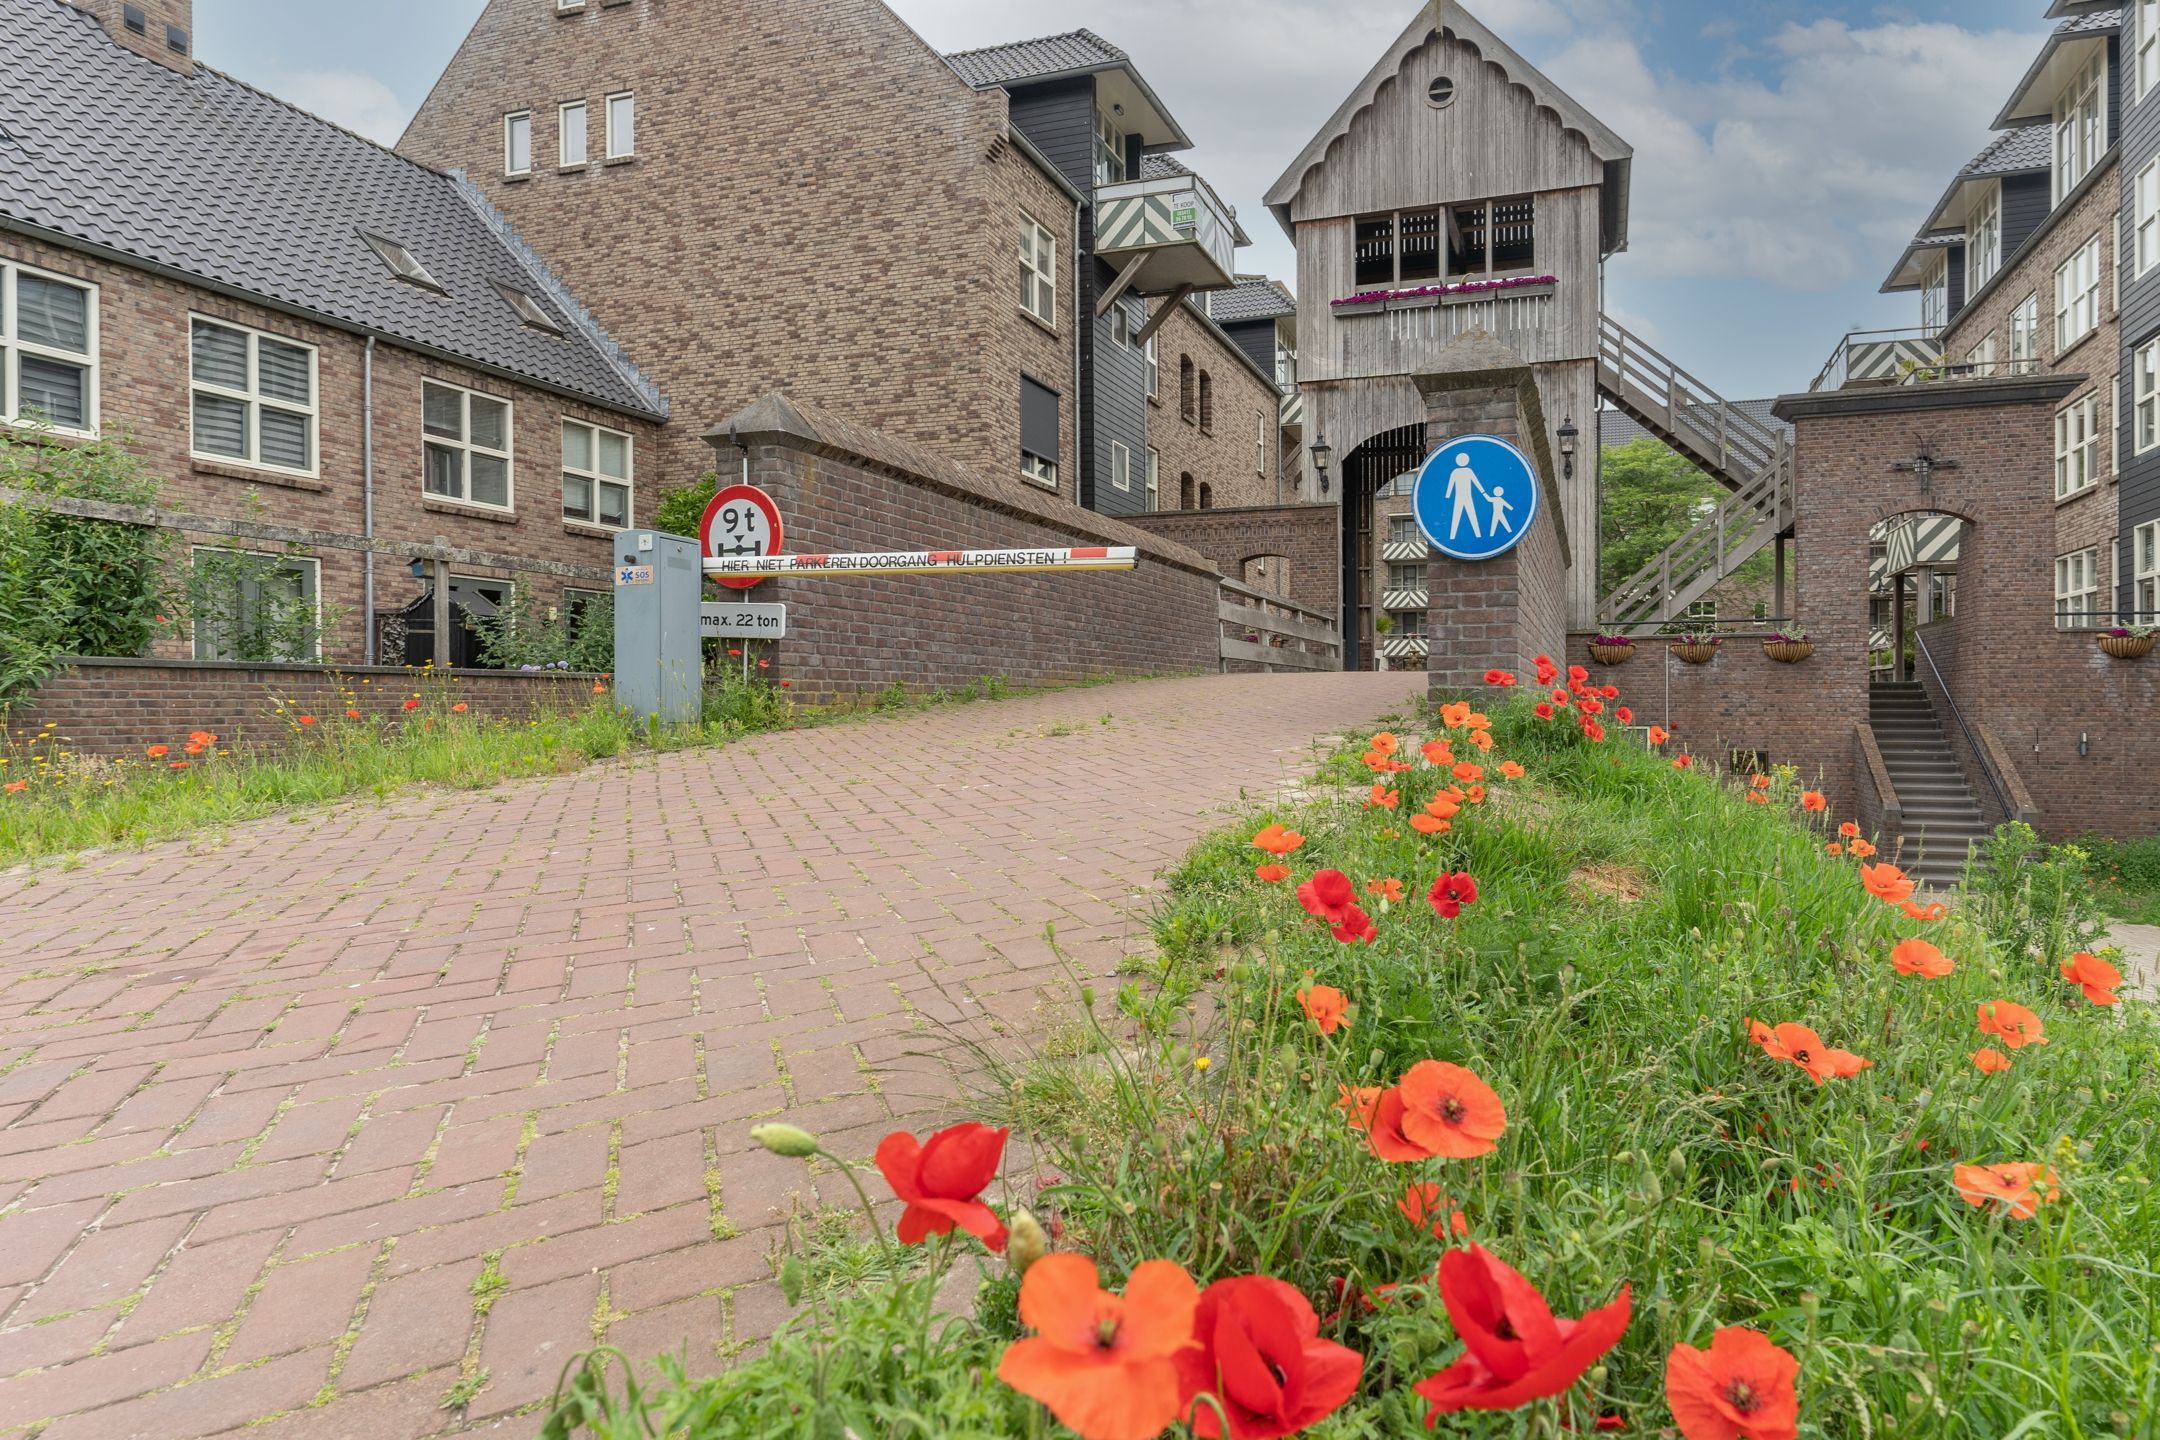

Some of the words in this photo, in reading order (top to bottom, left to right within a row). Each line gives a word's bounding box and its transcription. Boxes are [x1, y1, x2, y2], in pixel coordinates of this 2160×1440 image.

[722, 508, 739, 534] 9
[744, 506, 756, 532] t
[721, 560, 749, 573] HIER
[756, 559, 785, 571] NIET
[789, 557, 856, 570] PARKEREN
[859, 553, 937, 568] DOORGANG
[946, 551, 1056, 566] HULPDIENSTEN
[635, 571, 650, 579] SOS
[700, 615, 732, 626] max.
[735, 613, 754, 627] 22
[757, 614, 779, 627] ton
